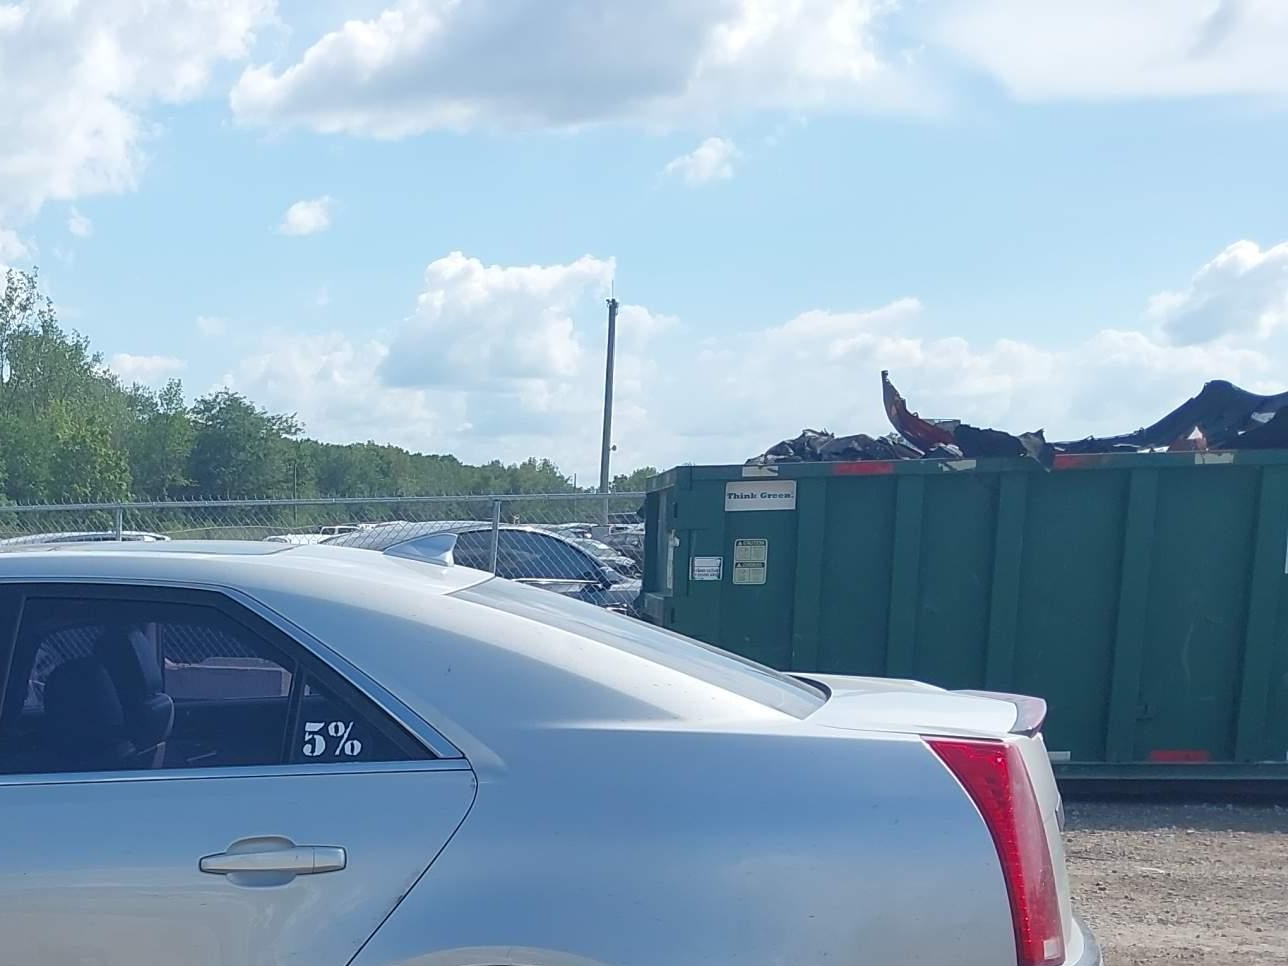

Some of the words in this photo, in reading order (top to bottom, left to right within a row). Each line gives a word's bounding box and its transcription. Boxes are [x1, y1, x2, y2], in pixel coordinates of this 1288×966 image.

[727, 492, 757, 500] Think
[759, 491, 795, 499] Green.
[302, 721, 362, 756] 5%
